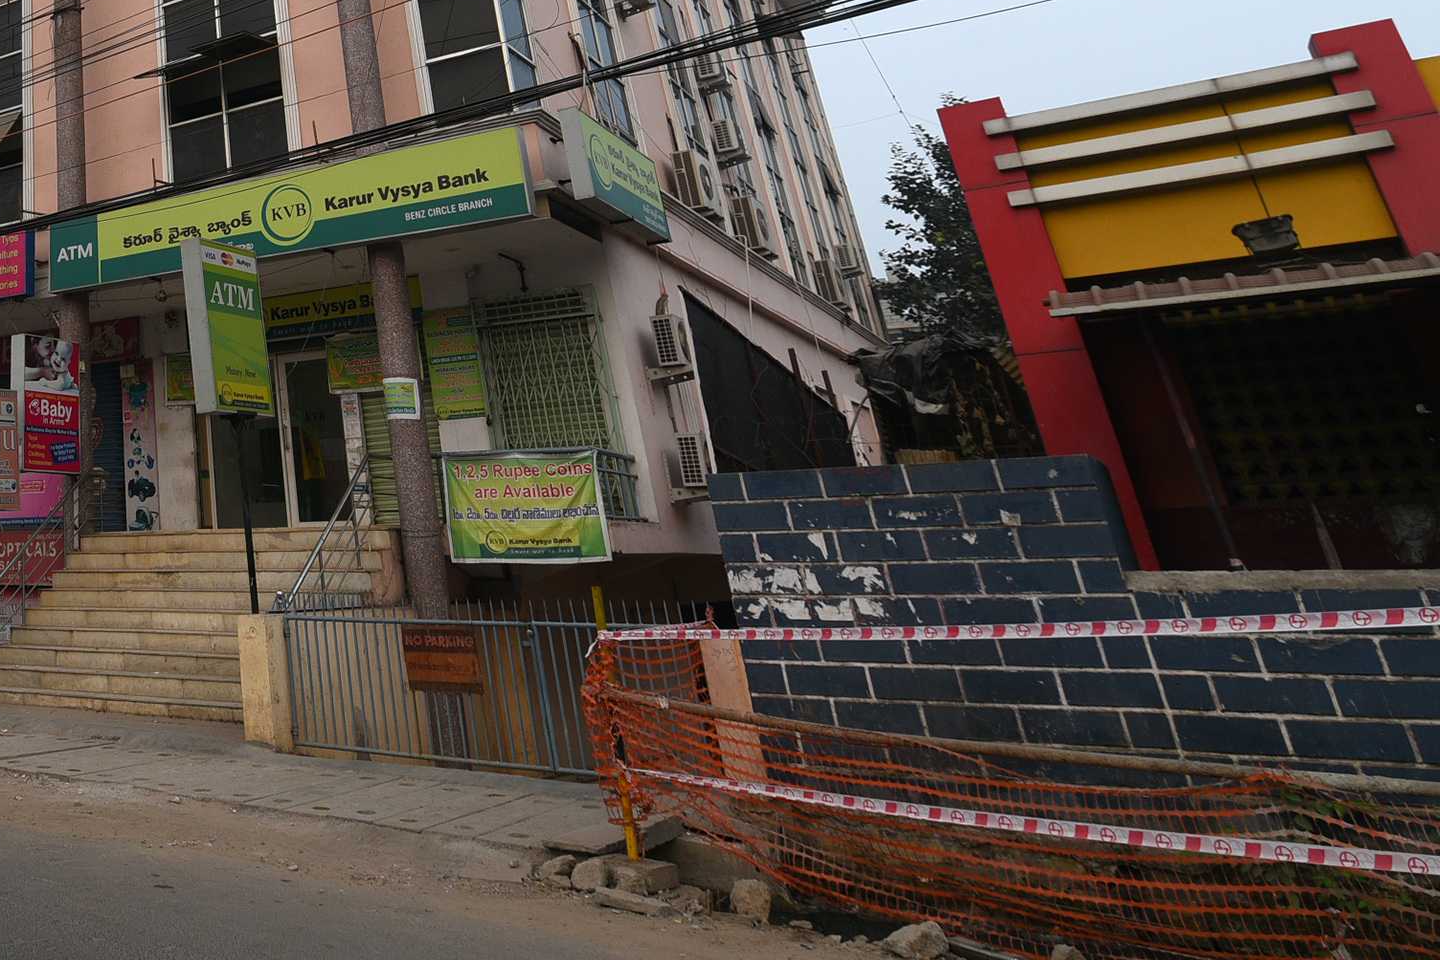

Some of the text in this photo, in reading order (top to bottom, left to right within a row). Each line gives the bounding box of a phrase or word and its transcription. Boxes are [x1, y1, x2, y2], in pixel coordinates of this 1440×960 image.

[324, 168, 489, 211] Karur Vysya Bank
[271, 202, 307, 222] KVB
[405, 197, 493, 221] BENZ CIRCLE BRANCH
[57, 242, 93, 263] ATM
[210, 280, 256, 311] ATM
[270, 304, 311, 321] Karur
[312, 298, 357, 317] Vysya
[40, 398, 72, 423] Baby
[43, 416, 65, 426] in Arms
[492, 463, 540, 480] Rupee
[545, 462, 593, 477] Coins
[474, 484, 575, 499] are Available
[405, 635, 474, 648] NO PARKING
